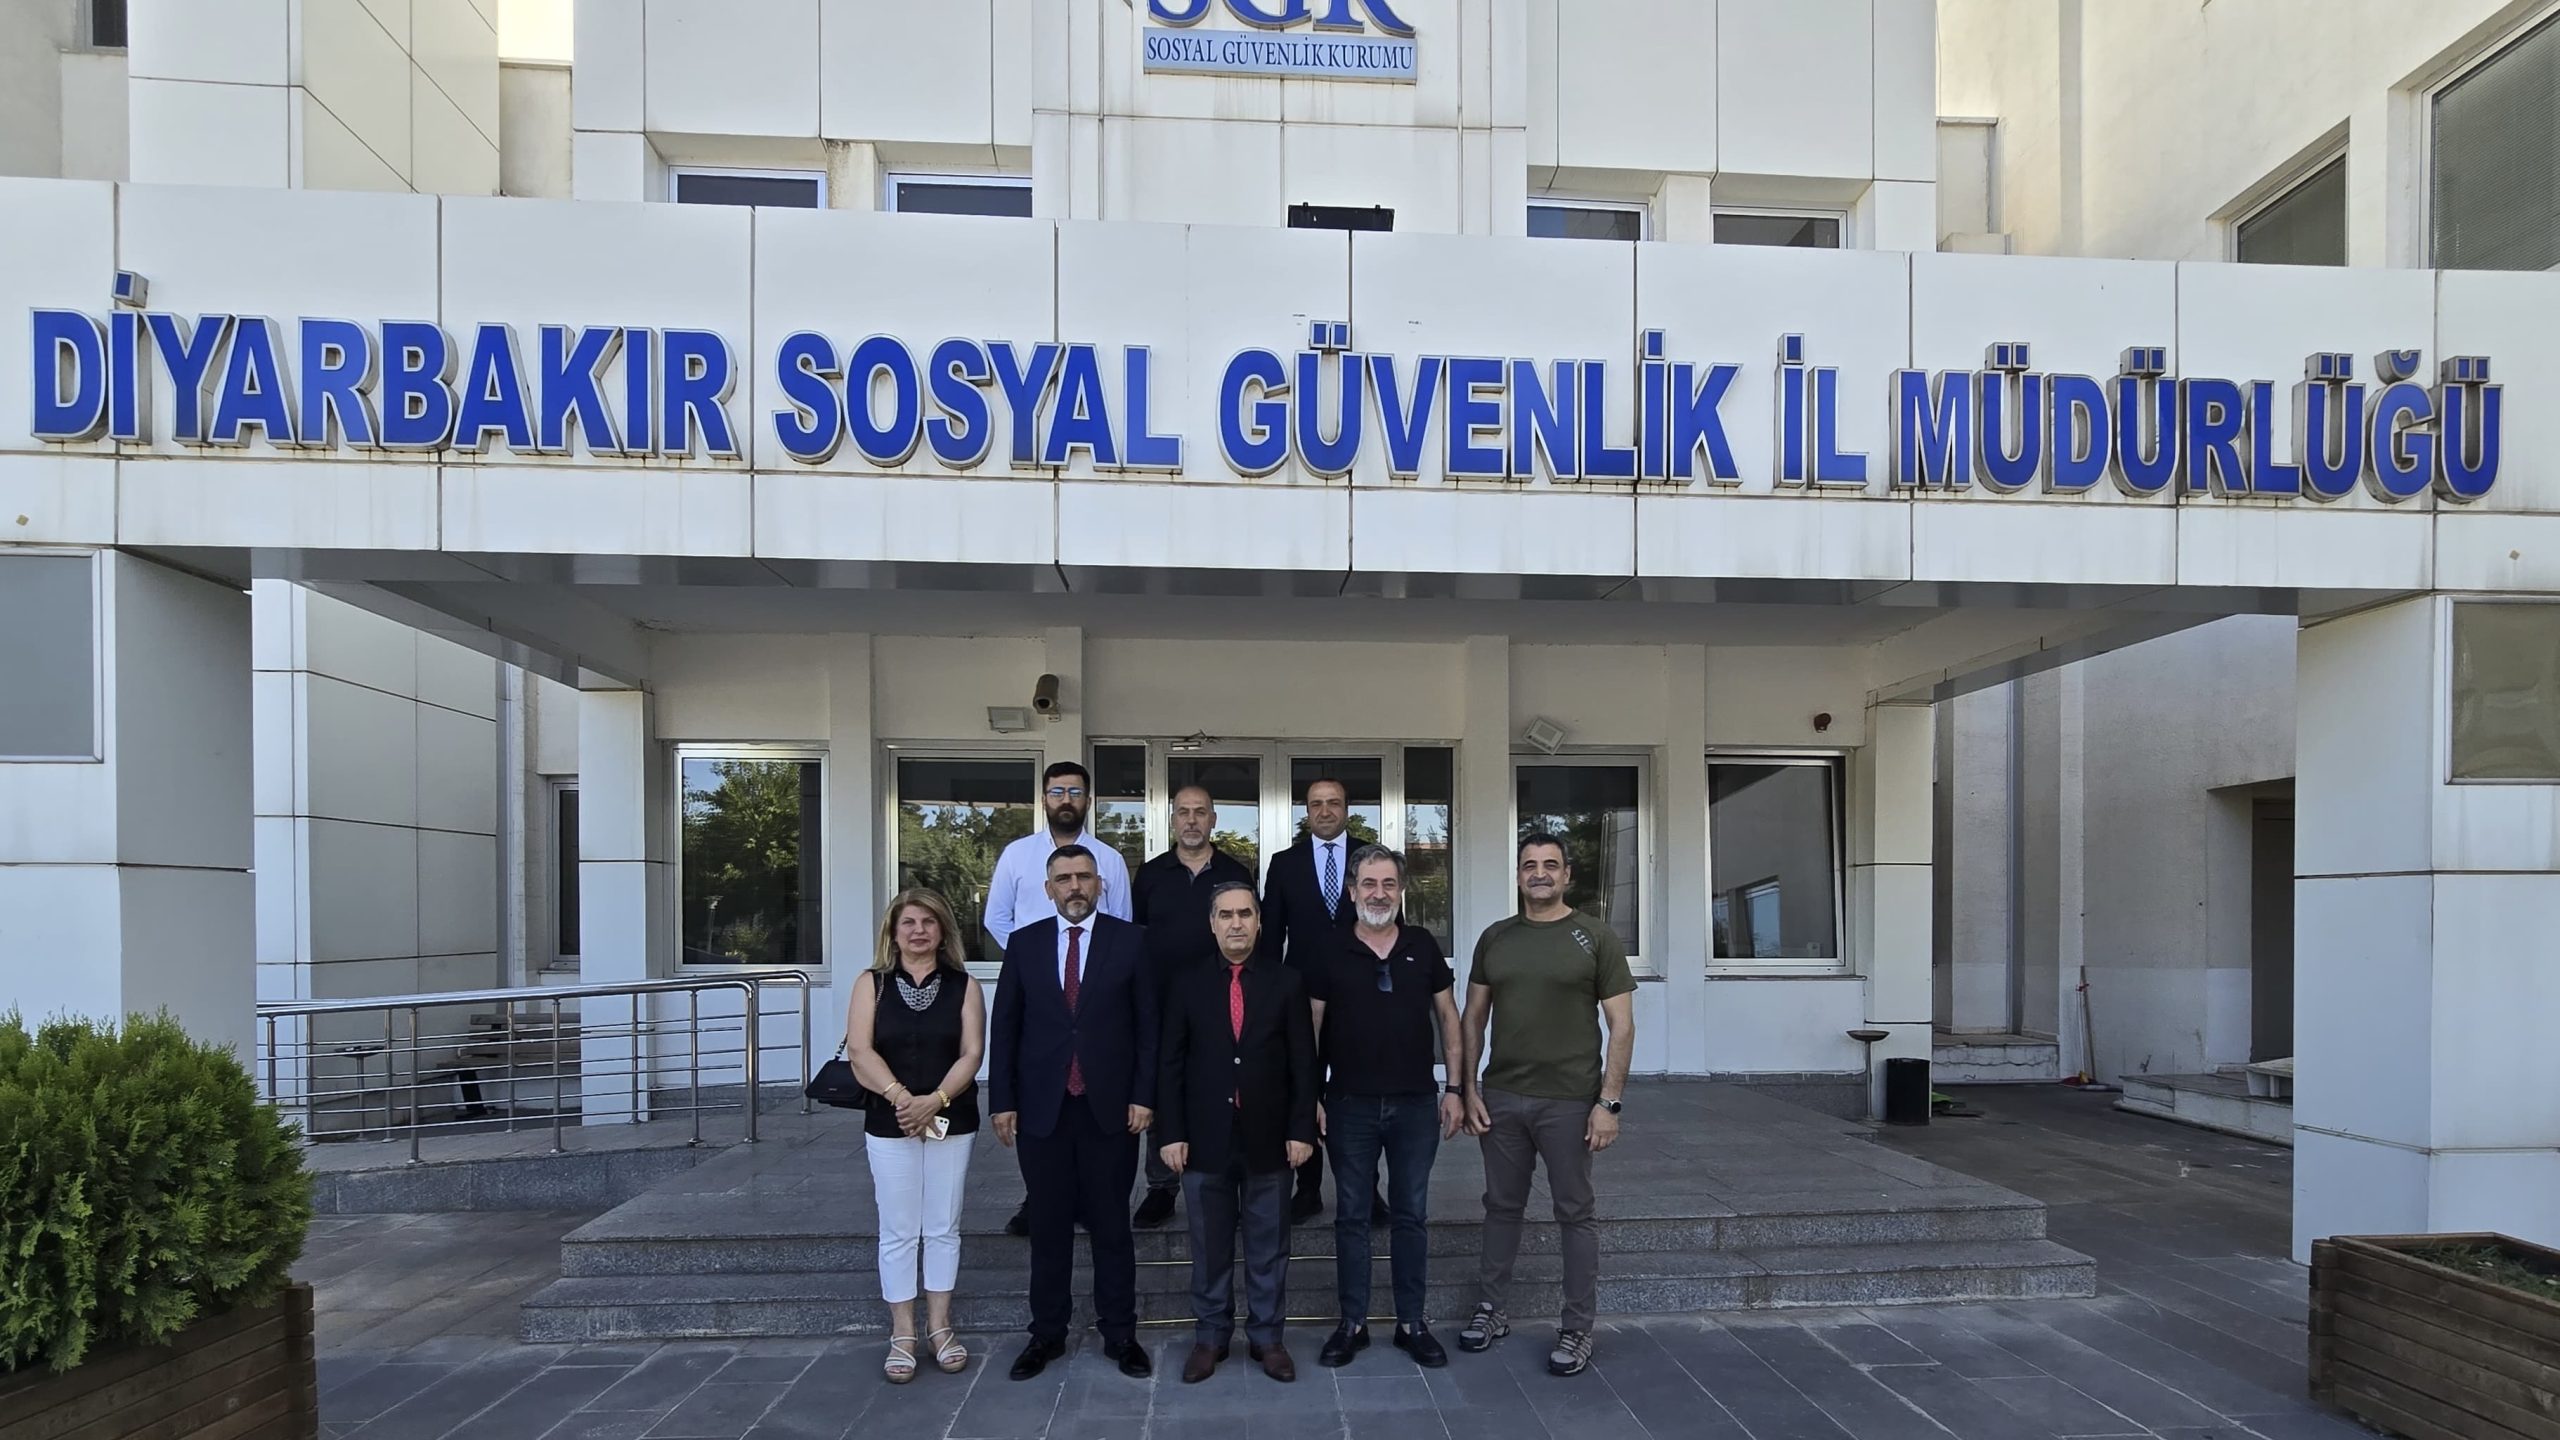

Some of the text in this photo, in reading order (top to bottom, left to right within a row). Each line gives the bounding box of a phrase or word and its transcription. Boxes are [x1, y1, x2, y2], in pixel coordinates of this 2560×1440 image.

[1146, 34, 1413, 69] SOSYAL GÜVENLİK KURUMU
[29, 269, 2503, 502] DİYARBAKIR SOSYAL GÜVENLİK İL MÜDÜRLÜĞÜ
